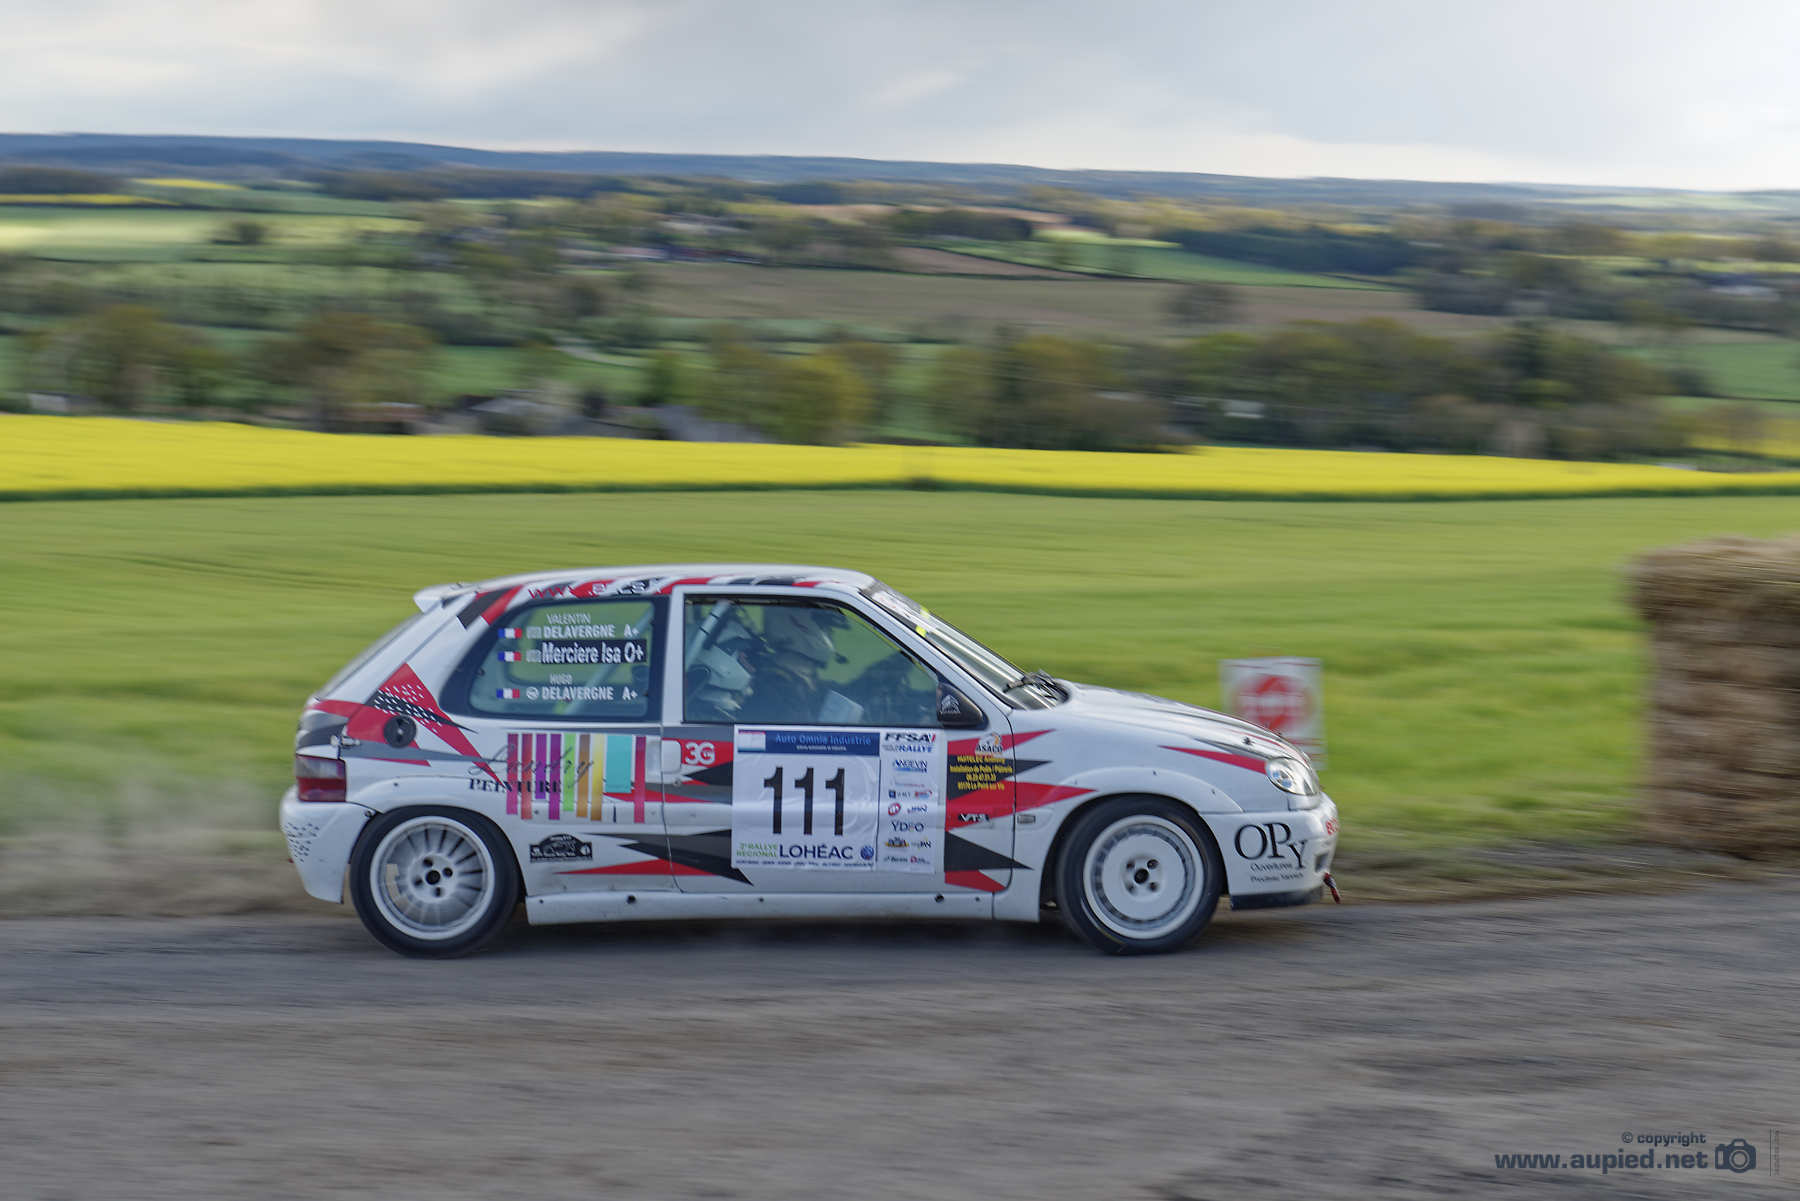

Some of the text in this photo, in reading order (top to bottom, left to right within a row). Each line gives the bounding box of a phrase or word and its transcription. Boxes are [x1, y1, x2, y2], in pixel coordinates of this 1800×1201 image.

[546, 613, 592, 624] VALENTIN
[543, 625, 616, 638] DELAVERGNE
[623, 624, 640, 638] A+
[602, 642, 621, 663] Isa
[624, 642, 644, 663] O+
[549, 673, 573, 685] HUGO
[542, 686, 638, 700] DELAVERGNE A+
[775, 734, 797, 744] Auto
[885, 732, 931, 743] FFSA
[763, 766, 845, 836] 111
[779, 843, 854, 860] LOHÉAC
